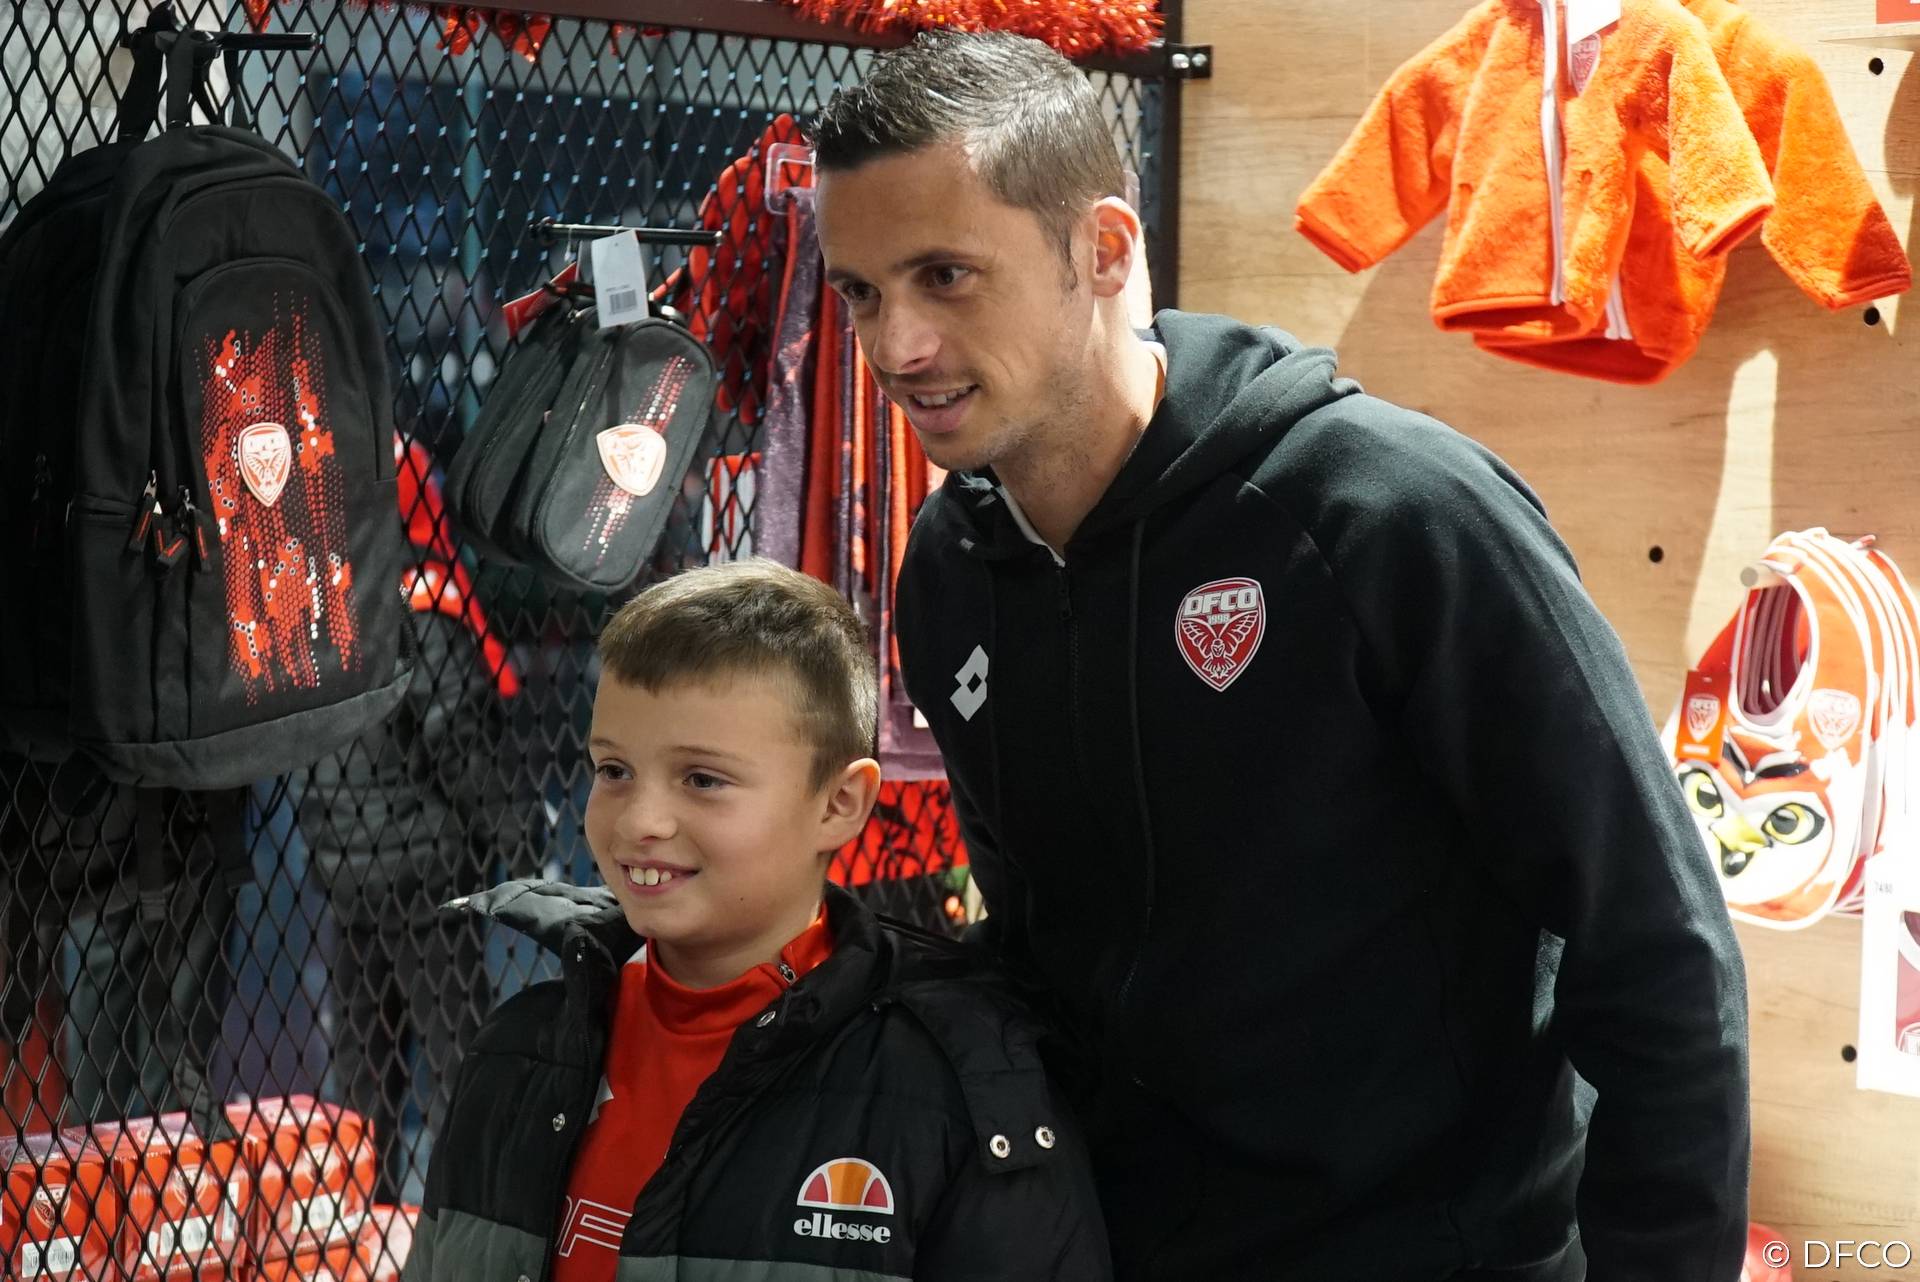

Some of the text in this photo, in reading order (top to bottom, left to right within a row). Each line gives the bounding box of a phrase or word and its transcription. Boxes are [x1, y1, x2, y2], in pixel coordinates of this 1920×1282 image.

[1183, 587, 1259, 616] DFCO
[1206, 613, 1231, 625] 1998
[793, 1212, 892, 1244] ellesse
